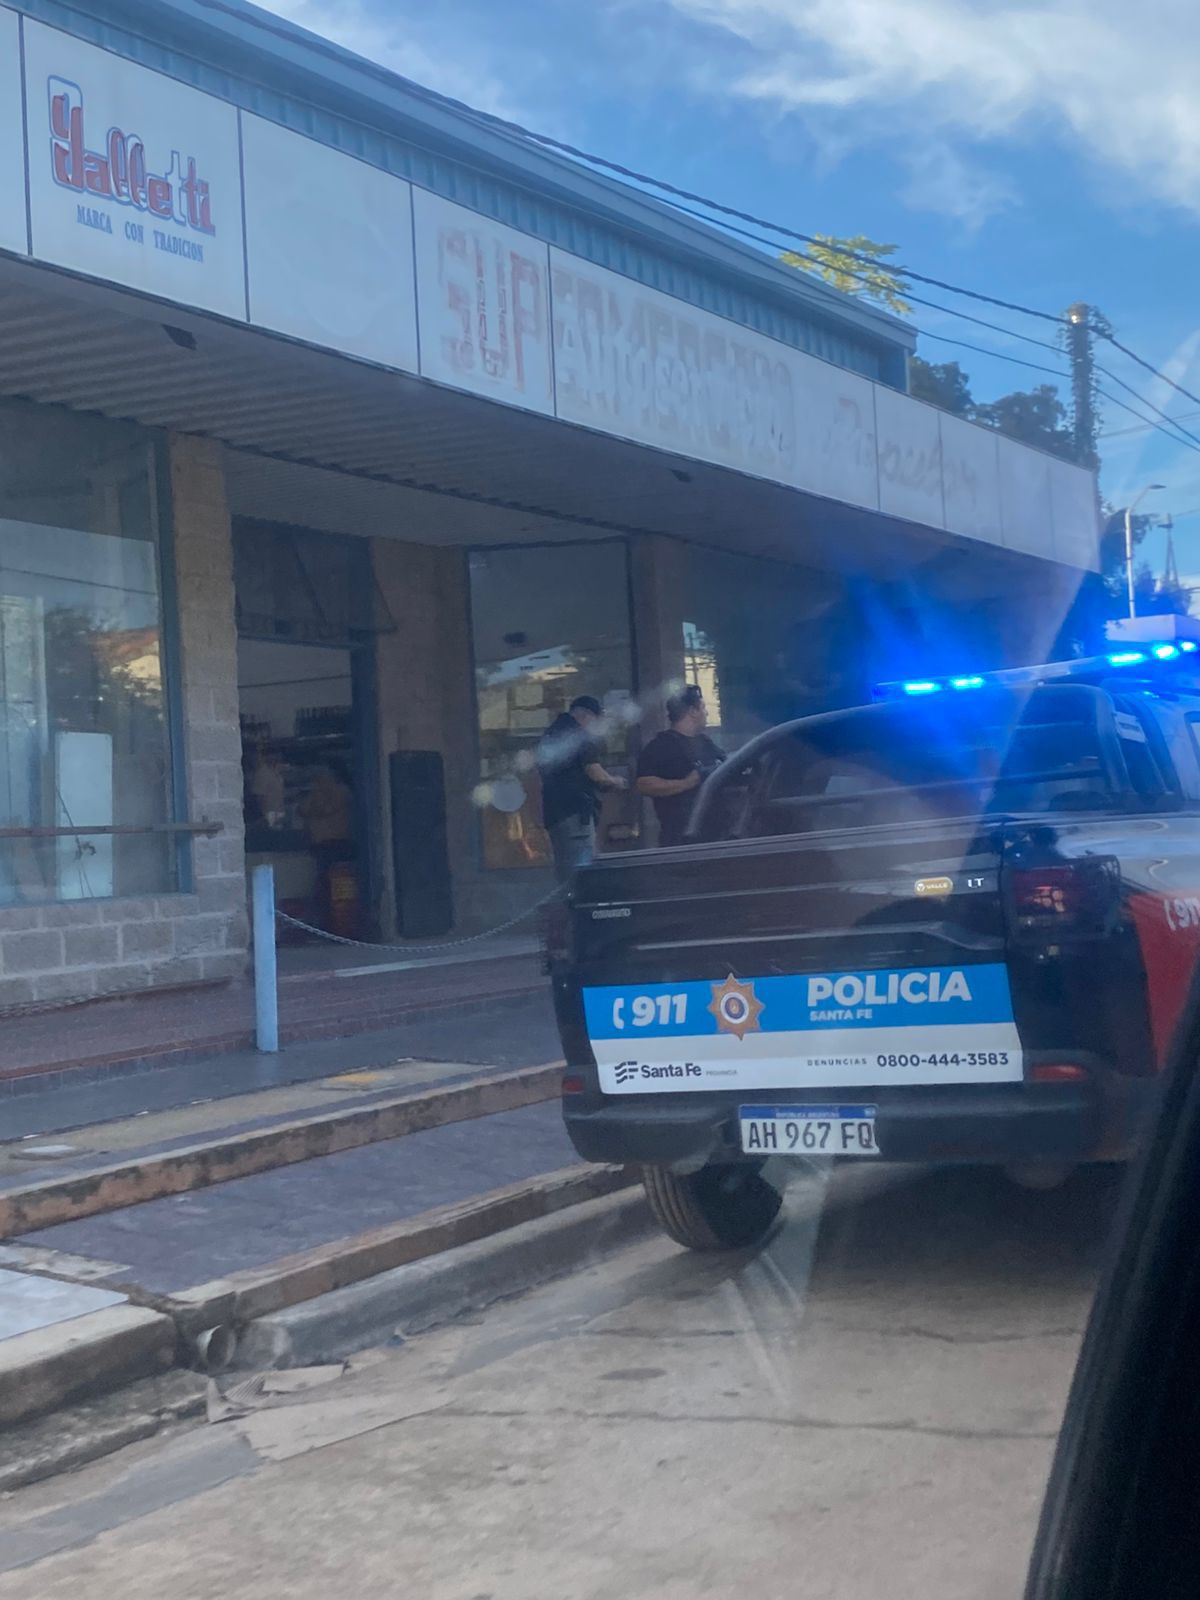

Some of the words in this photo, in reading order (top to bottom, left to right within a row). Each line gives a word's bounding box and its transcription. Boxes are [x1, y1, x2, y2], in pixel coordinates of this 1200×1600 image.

[76, 204, 113, 235] MARCA
[124, 220, 144, 245] CON
[153, 229, 204, 264] TRADICION
[967, 877, 984, 889] LT
[807, 970, 973, 1007] POLICIA
[632, 993, 688, 1027] 911
[809, 1009, 854, 1022] SANTA
[856, 1008, 873, 1019] FE
[807, 1058, 868, 1067] DENUNCIAS
[877, 1052, 1009, 1068] 0800-444-3583
[640, 1064, 684, 1079] Santa
[686, 1062, 702, 1077] Fe
[748, 1121, 778, 1149] AH
[784, 1121, 832, 1149] 967
[840, 1121, 874, 1149] FQ
